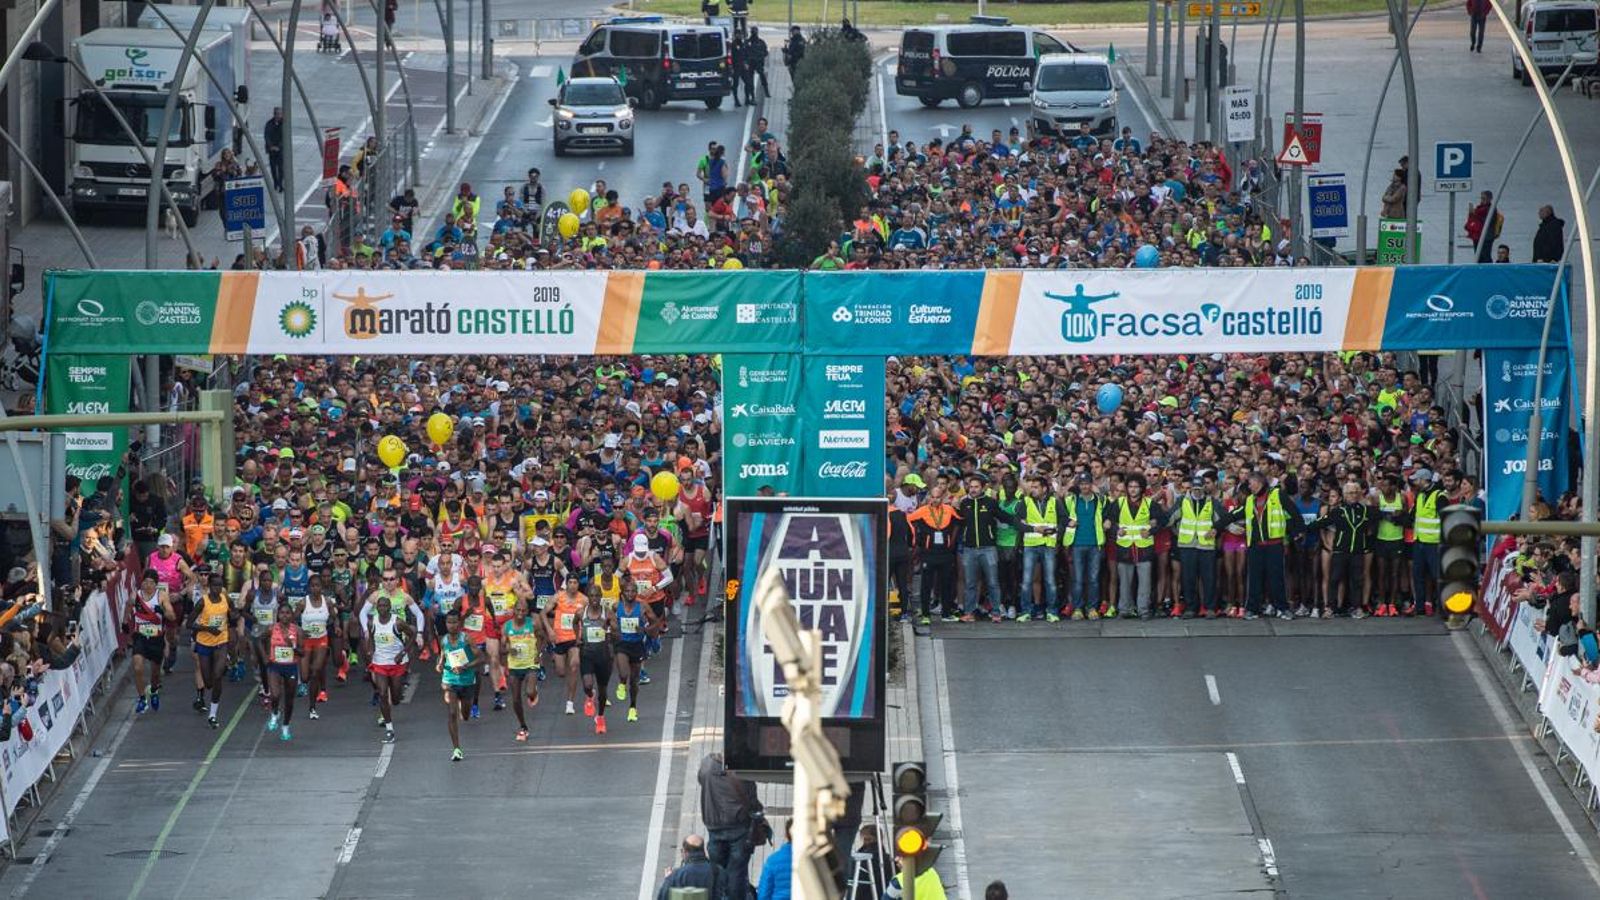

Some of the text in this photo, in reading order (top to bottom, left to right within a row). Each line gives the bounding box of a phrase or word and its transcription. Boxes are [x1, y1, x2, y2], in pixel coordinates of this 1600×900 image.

[986, 66, 1030, 77] POLICIA
[1443, 148, 1465, 174] P
[302, 287, 317, 299] bp
[534, 286, 560, 302] 2019
[1295, 283, 1322, 300] 2019
[159, 306, 201, 316] RUNNING
[910, 304, 942, 313] Cultura
[349, 302, 574, 334] marató CASTELLÓ
[909, 314, 951, 324] Esfuerzo
[1065, 312, 1095, 337] 10K
[1222, 306, 1322, 335] castelló
[68, 366, 106, 375] SEMPRE
[826, 364, 863, 373] SEMPRE
[826, 373, 852, 381] TEUA
[750, 404, 796, 413] CaixaBank
[778, 516, 853, 560] A
